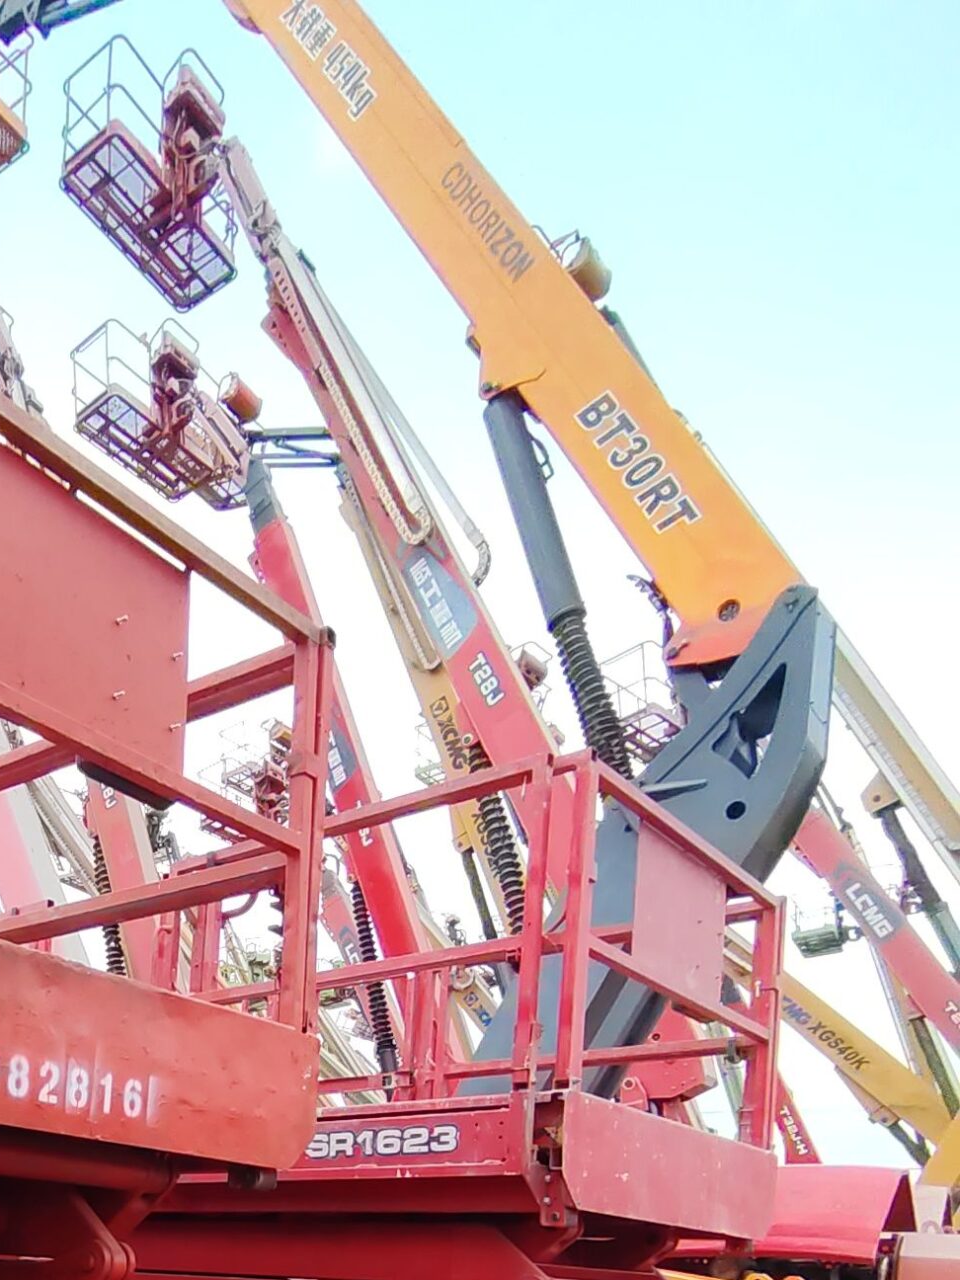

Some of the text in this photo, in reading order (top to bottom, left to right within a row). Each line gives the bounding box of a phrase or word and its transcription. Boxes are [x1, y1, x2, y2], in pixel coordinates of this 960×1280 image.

[324, 41, 377, 120] 454kg
[440, 161, 535, 283] CDHORIZON
[575, 391, 701, 533] BT30RT
[468, 651, 506, 707] T28J
[437, 713, 468, 770] XCMG
[807, 1020, 871, 1071] XGS40K
[305, 1124, 458, 1158] SR1623
